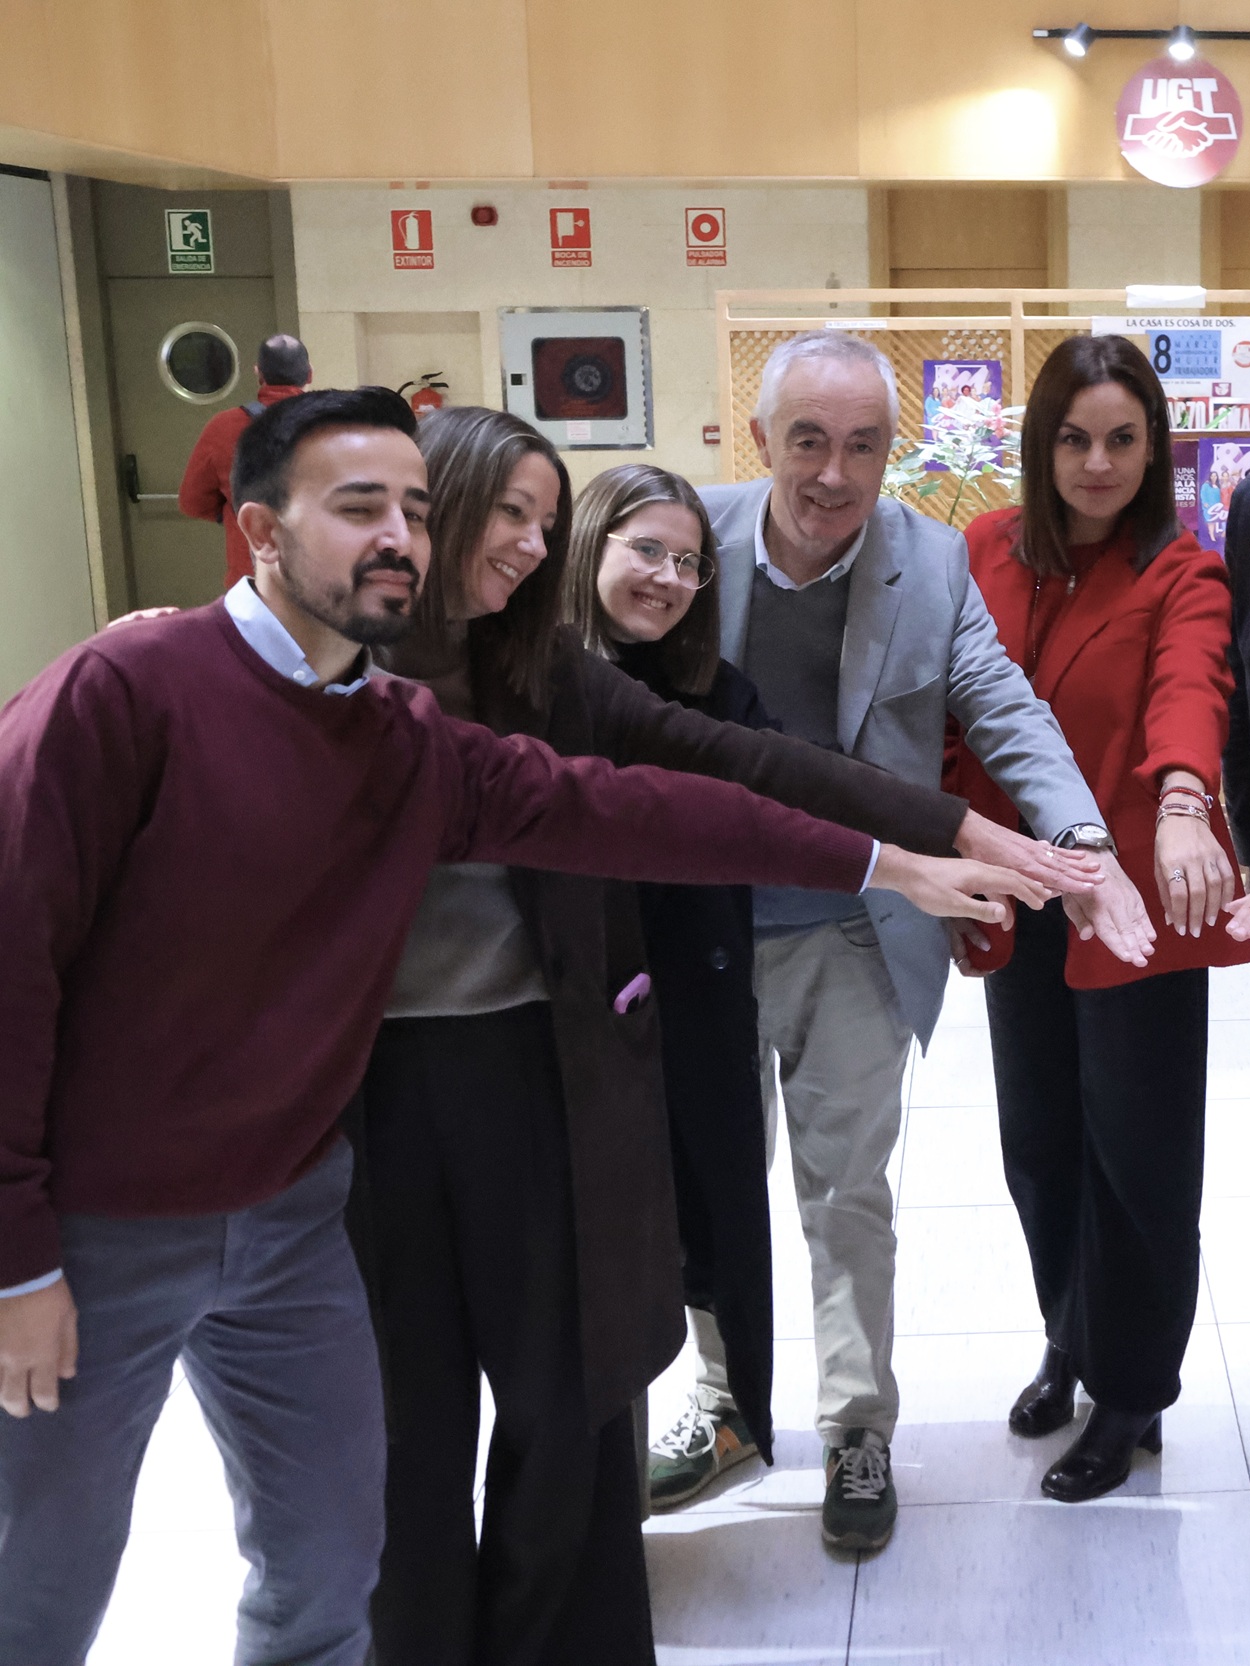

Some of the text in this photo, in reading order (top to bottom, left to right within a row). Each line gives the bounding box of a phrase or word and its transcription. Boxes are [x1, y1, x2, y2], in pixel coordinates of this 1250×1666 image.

[1140, 78, 1219, 114] UGT
[395, 255, 433, 267] EXTINTOR
[1126, 319, 1236, 328] LA CASA ES COSA DE DOS.
[1153, 334, 1172, 374] 8
[1168, 401, 1206, 429] ARZO
